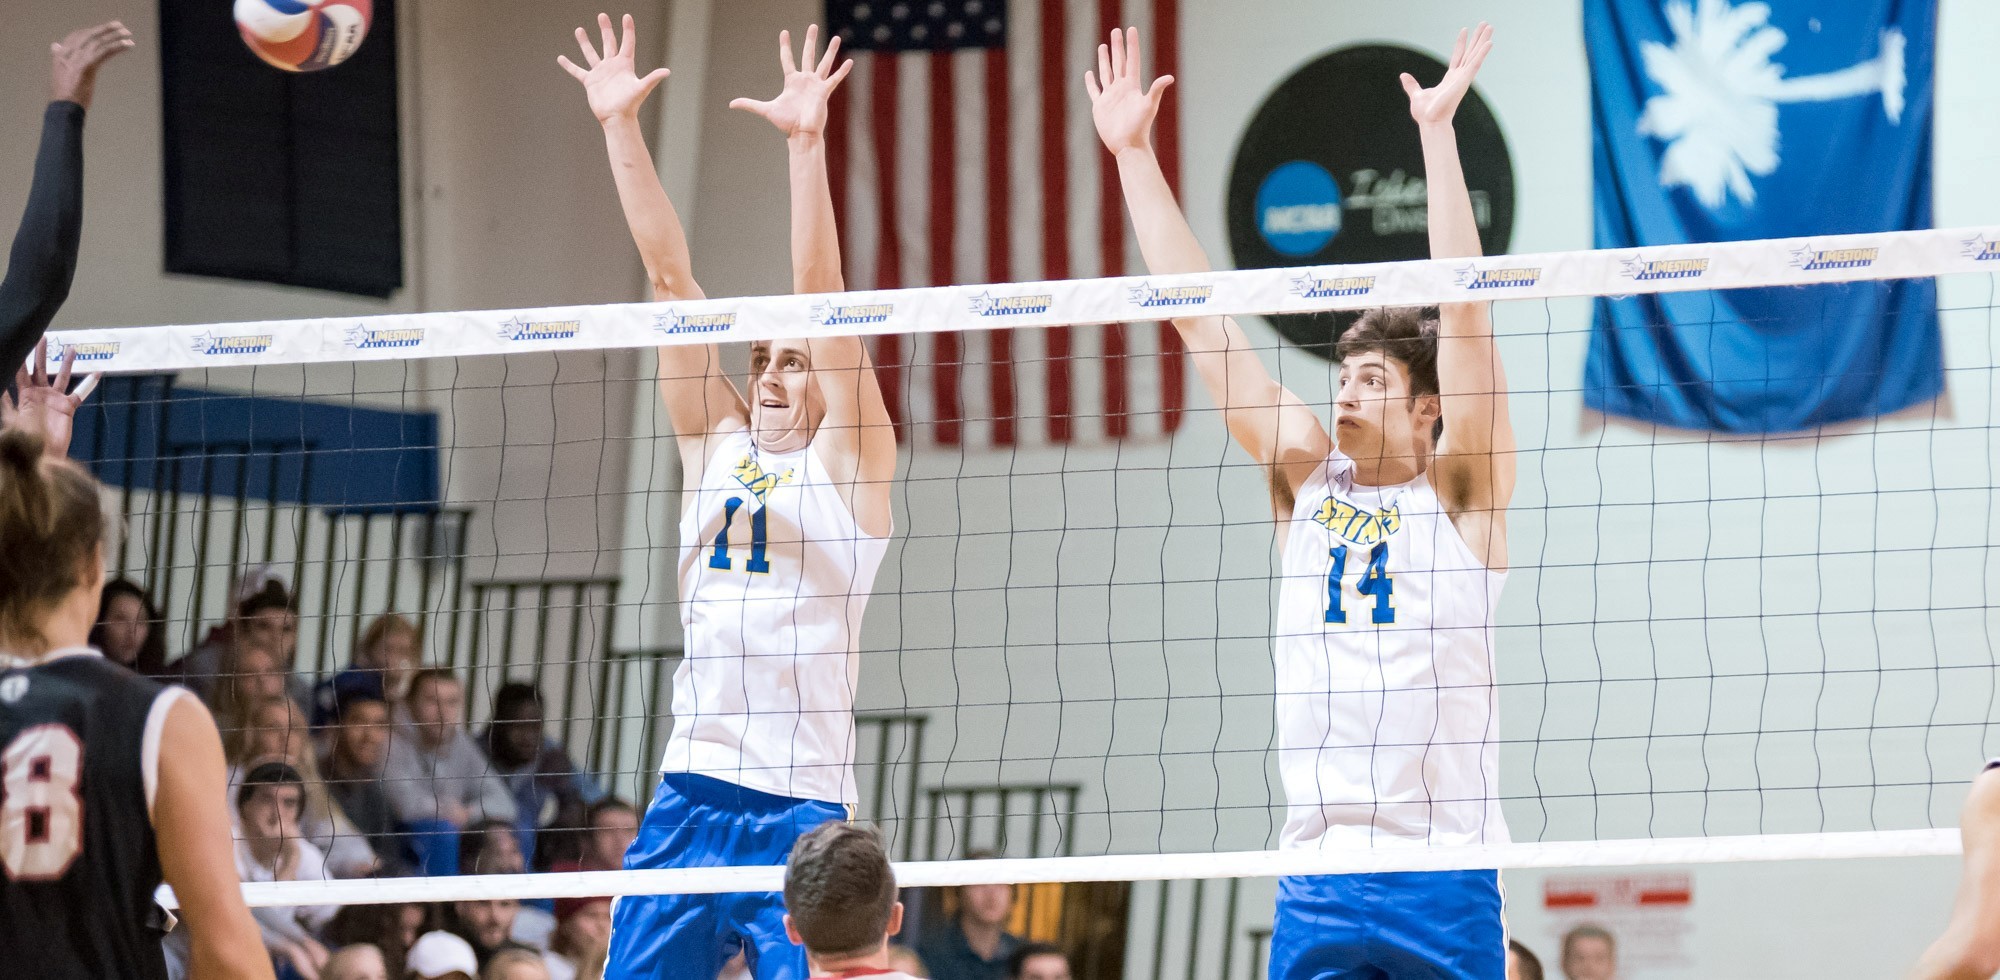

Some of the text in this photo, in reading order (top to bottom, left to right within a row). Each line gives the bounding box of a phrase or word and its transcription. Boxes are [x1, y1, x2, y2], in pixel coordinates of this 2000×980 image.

[1814, 247, 1879, 262] LIMESTONE
[1644, 258, 1709, 273] LIMESTONE
[1477, 268, 1541, 283] LIMESTONE
[1314, 276, 1375, 291] LIMESTONE
[1152, 285, 1213, 300] LIMESTONE
[991, 295, 1052, 309] LIMESTONE
[833, 304, 893, 318] LIMESTONE
[521, 320, 580, 333] LIMESTONE
[677, 313, 736, 326] LIMESTONE
[214, 335, 272, 348] LIMESTONE
[368, 328, 424, 341] LIMESTONE
[63, 342, 120, 354] LMESTONE
[708, 496, 770, 574] 11
[1325, 541, 1396, 624] 14
[0, 722, 85, 882] 8
